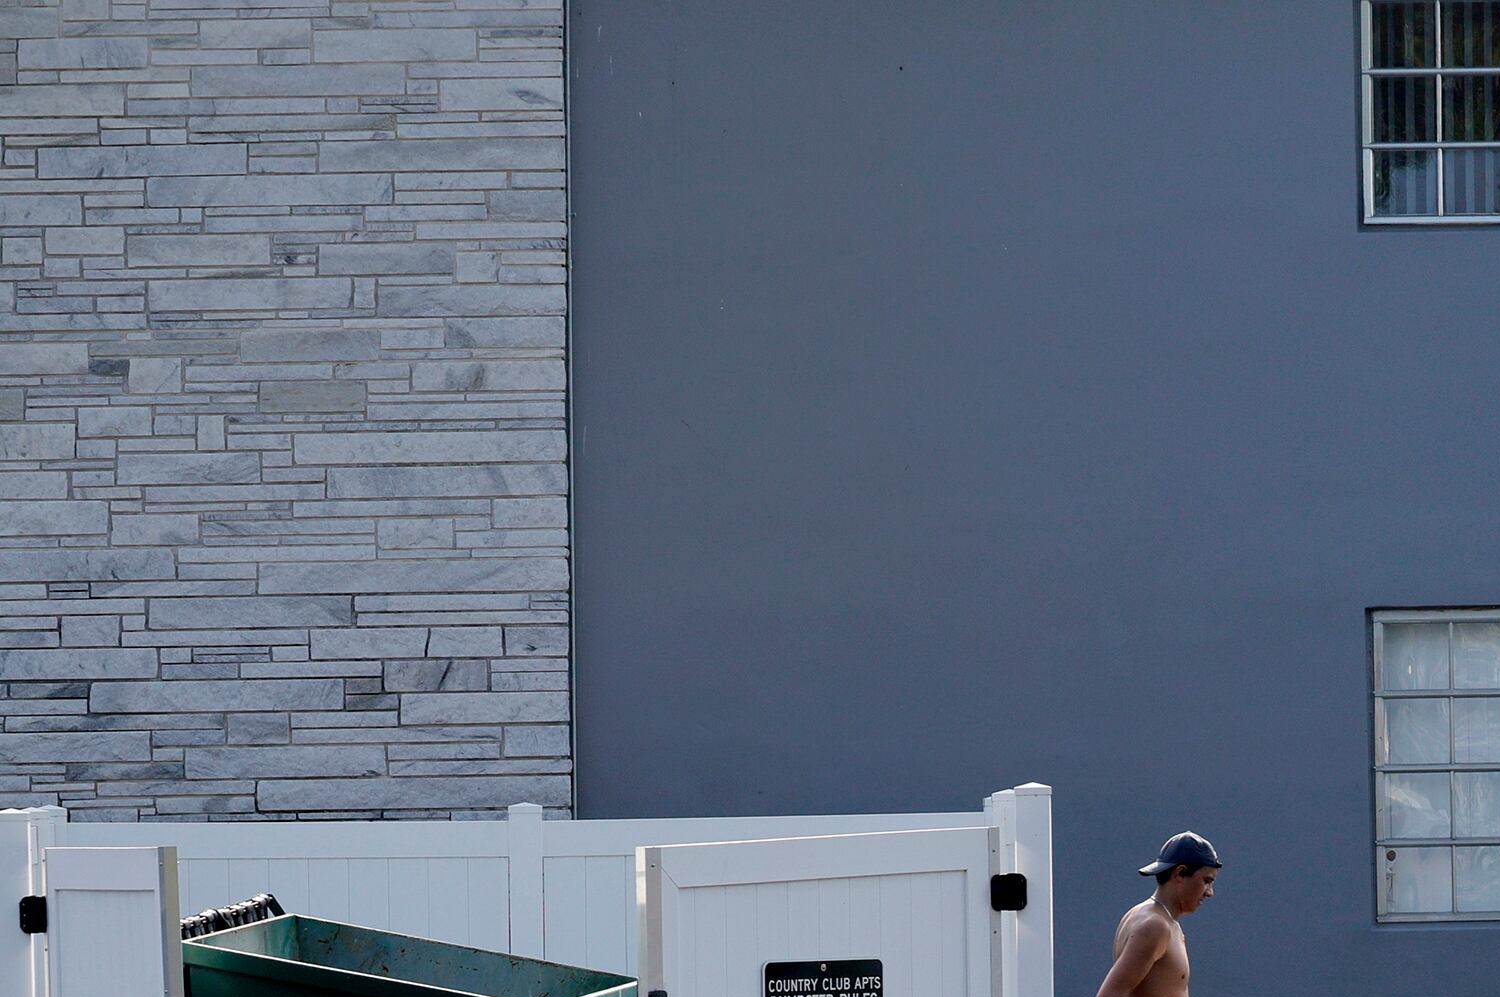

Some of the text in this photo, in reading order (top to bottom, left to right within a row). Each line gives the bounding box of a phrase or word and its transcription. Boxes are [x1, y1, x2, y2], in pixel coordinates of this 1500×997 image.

[768, 976, 881, 992] COUNTRY CLUB APTS
